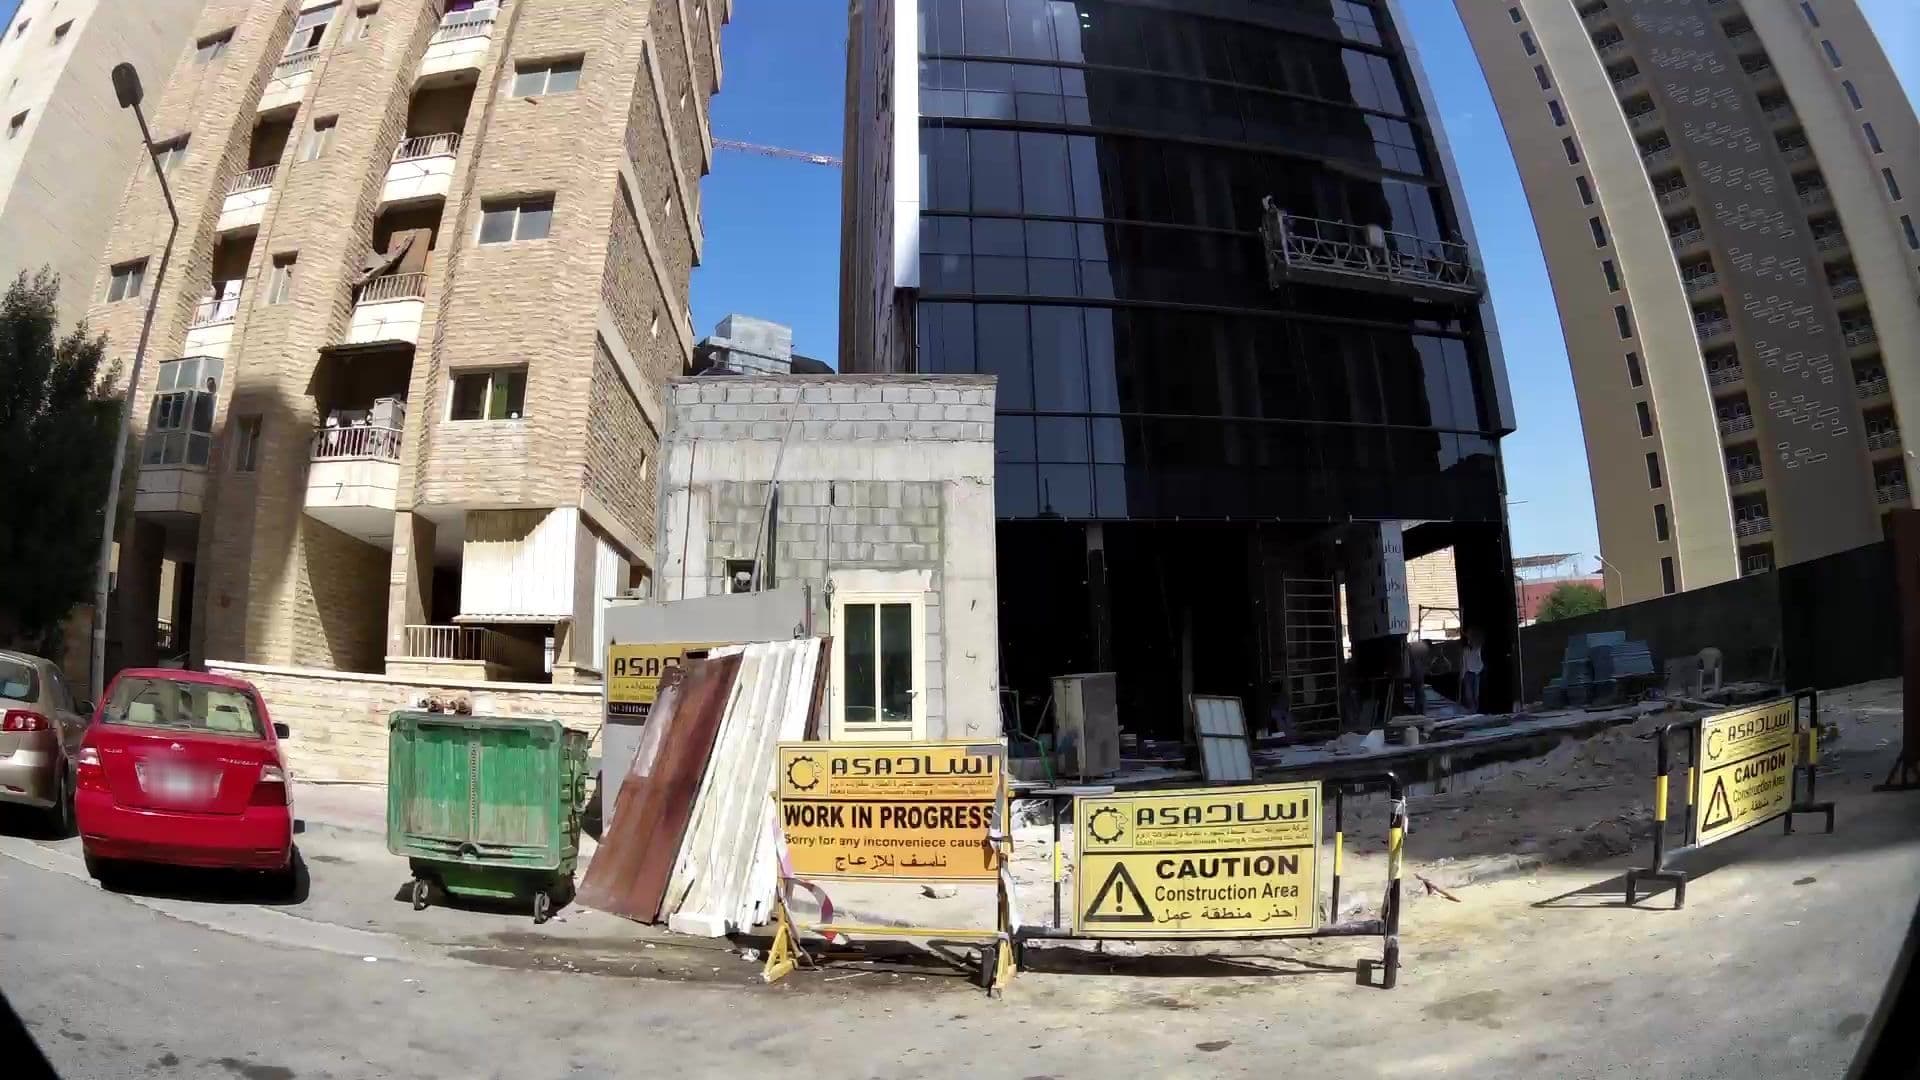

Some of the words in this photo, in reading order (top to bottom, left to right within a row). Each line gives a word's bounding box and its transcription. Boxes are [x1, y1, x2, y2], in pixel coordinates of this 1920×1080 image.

[1734, 751, 1785, 783] CAUTION
[784, 804, 844, 828] WORK
[852, 805, 872, 828] IN
[880, 806, 993, 829] PROGRESS
[784, 833, 815, 847] Sorry
[819, 835, 835, 846] for
[839, 837, 860, 848] any
[864, 836, 946, 848] inconveniece
[1156, 855, 1299, 880] CAUTION
[1155, 884, 1257, 901] Construction
[1262, 882, 1299, 899] Area
[1157, 909, 1192, 923] عمل
[1201, 905, 1252, 920] منطقة
